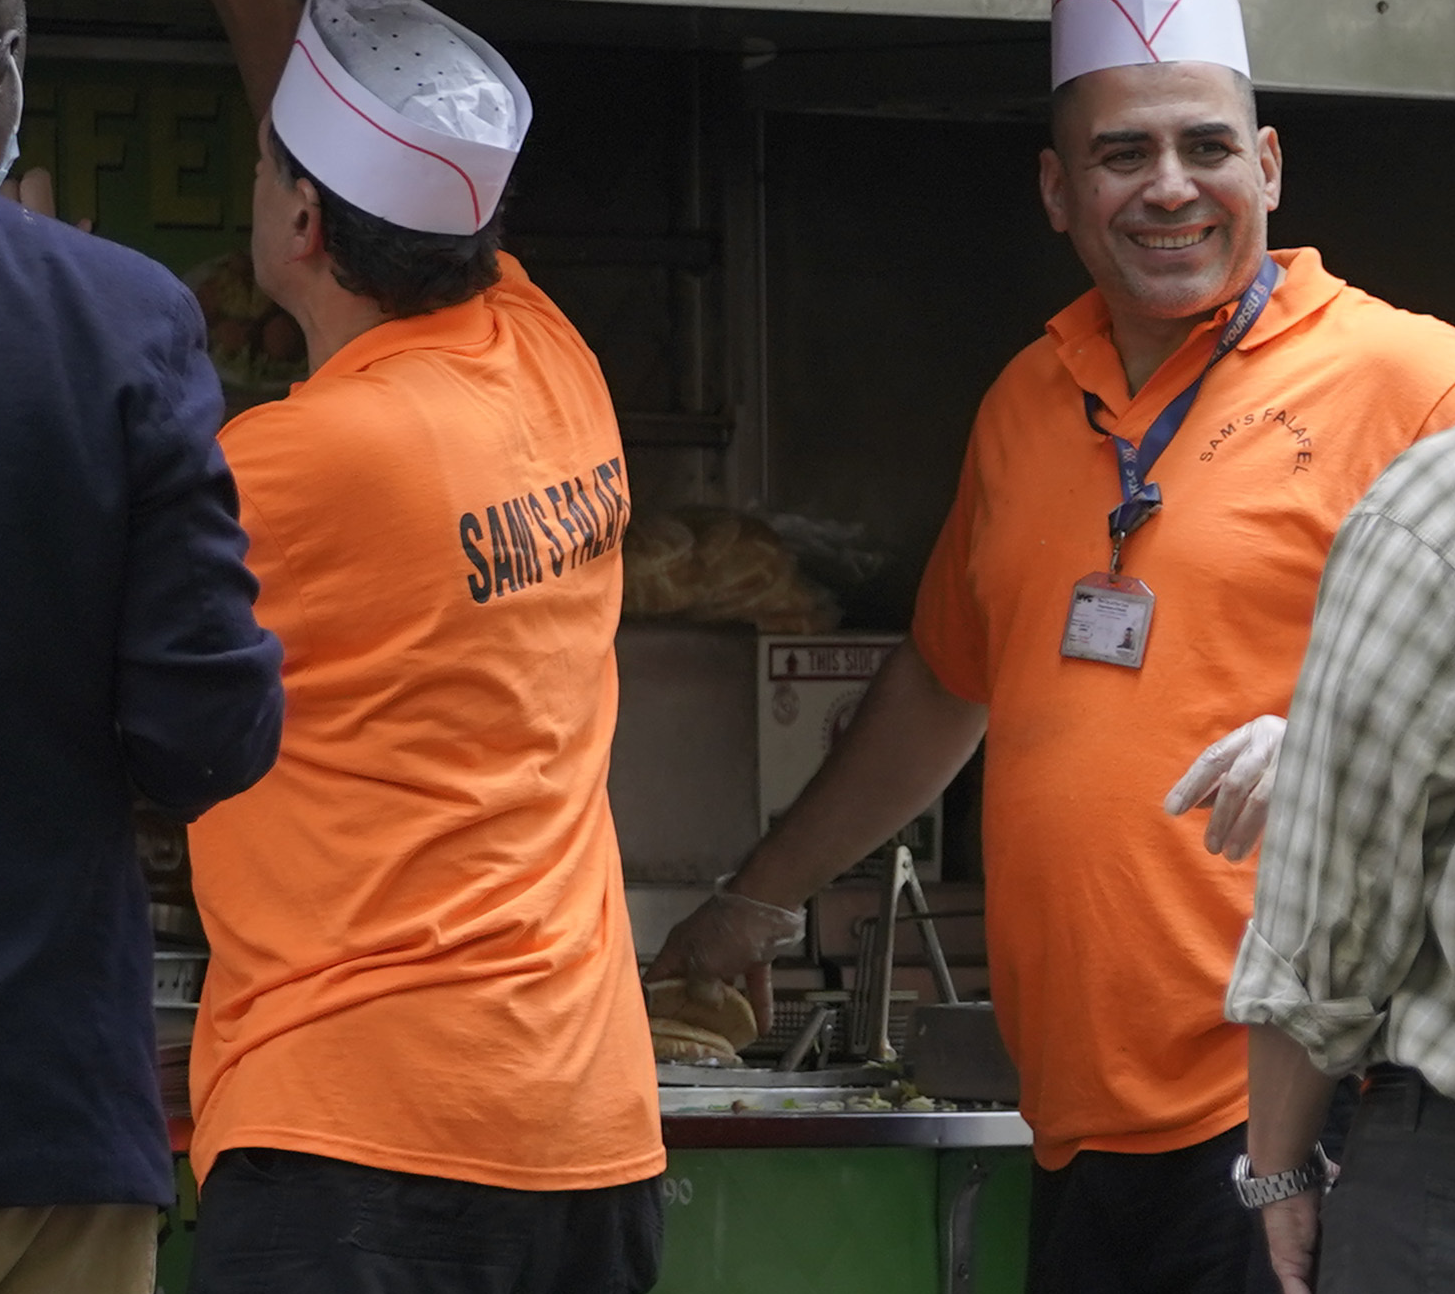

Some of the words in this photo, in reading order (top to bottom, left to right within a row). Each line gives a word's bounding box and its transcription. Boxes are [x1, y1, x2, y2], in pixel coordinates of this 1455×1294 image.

[1221, 294, 1261, 347] YOURSELF
[1200, 412, 1255, 463] SAM'S
[1262, 407, 1312, 475] FALAFEL
[459, 492, 565, 604] SAM'S
[545, 457, 631, 569] FALAFE
